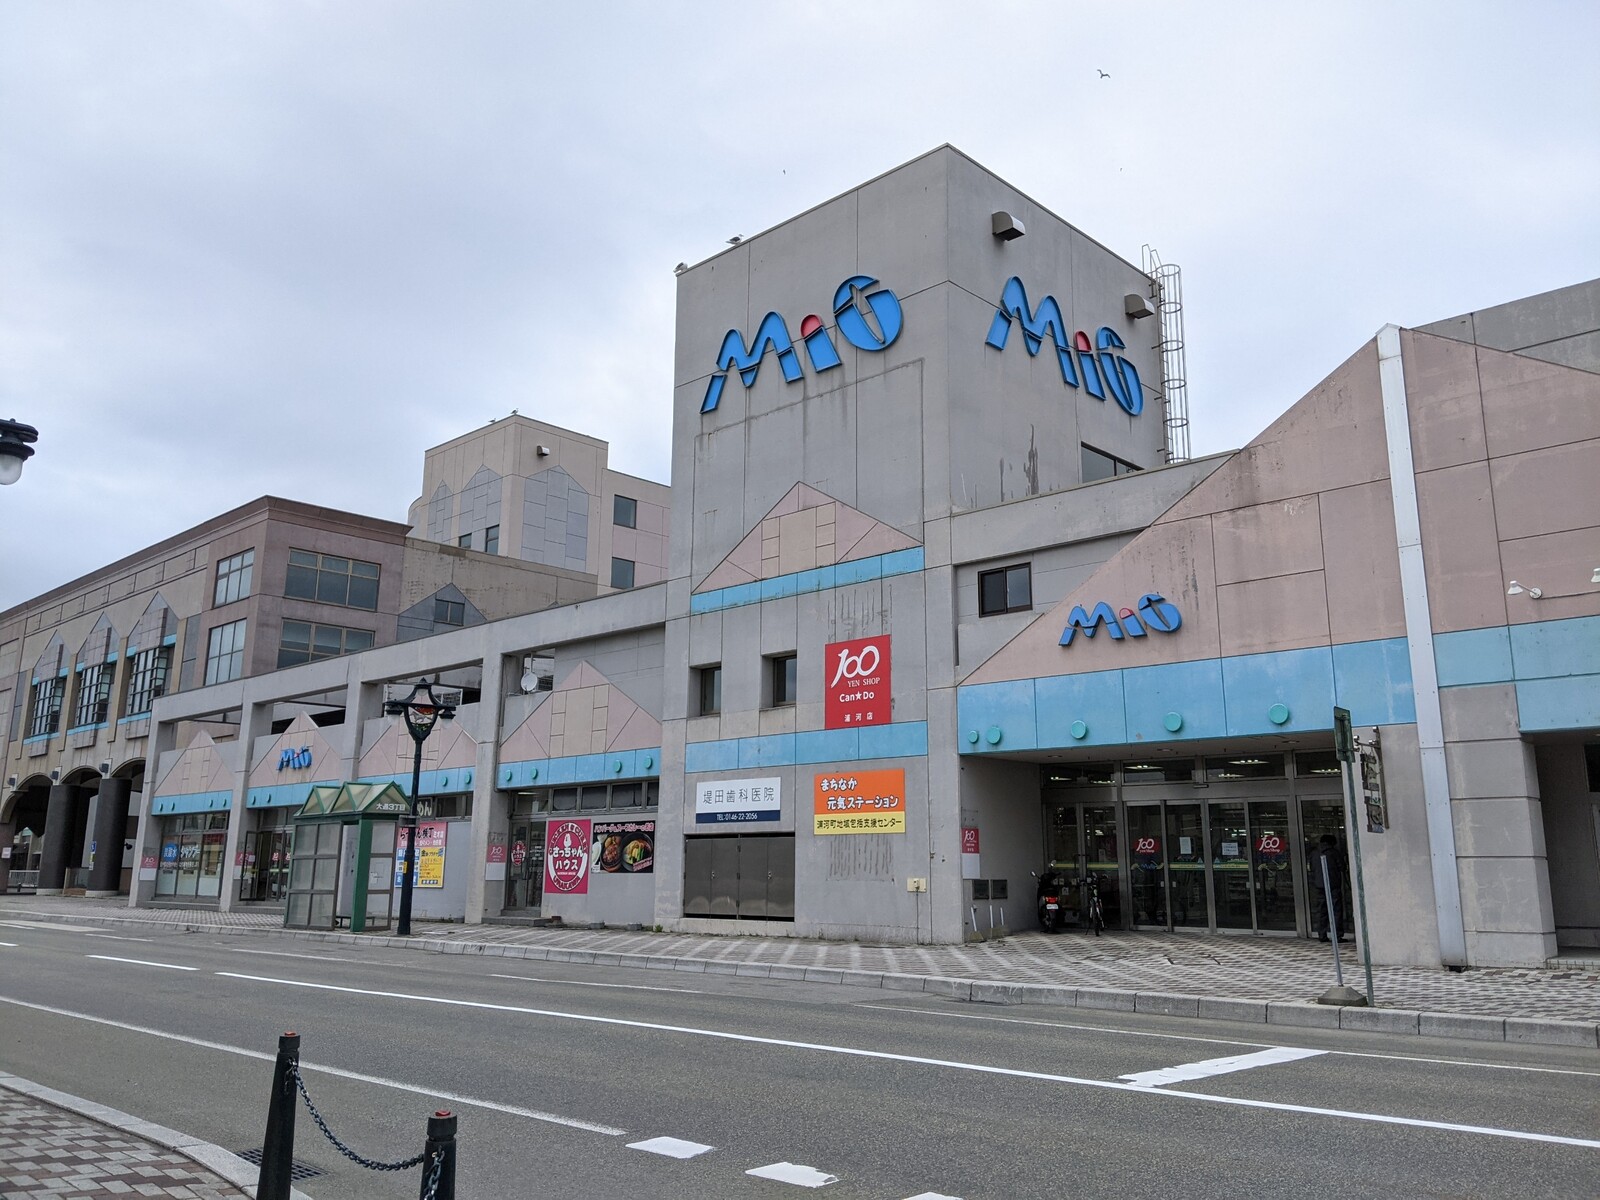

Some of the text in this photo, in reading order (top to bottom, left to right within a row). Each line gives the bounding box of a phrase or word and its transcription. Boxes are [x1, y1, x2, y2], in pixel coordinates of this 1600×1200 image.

[831, 645, 880, 689] 100
[847, 677, 881, 688] YEN SHOP
[820, 777, 858, 792] まちなか
[827, 795, 899, 811] 元気ステーション
[816, 817, 902, 830] 浦河町地域包括支援センター
[1135, 838, 1155, 852] 100
[1259, 835, 1280, 851] 100
[552, 844, 585, 858] さっちゃん
[555, 859, 579, 871] ハウス
